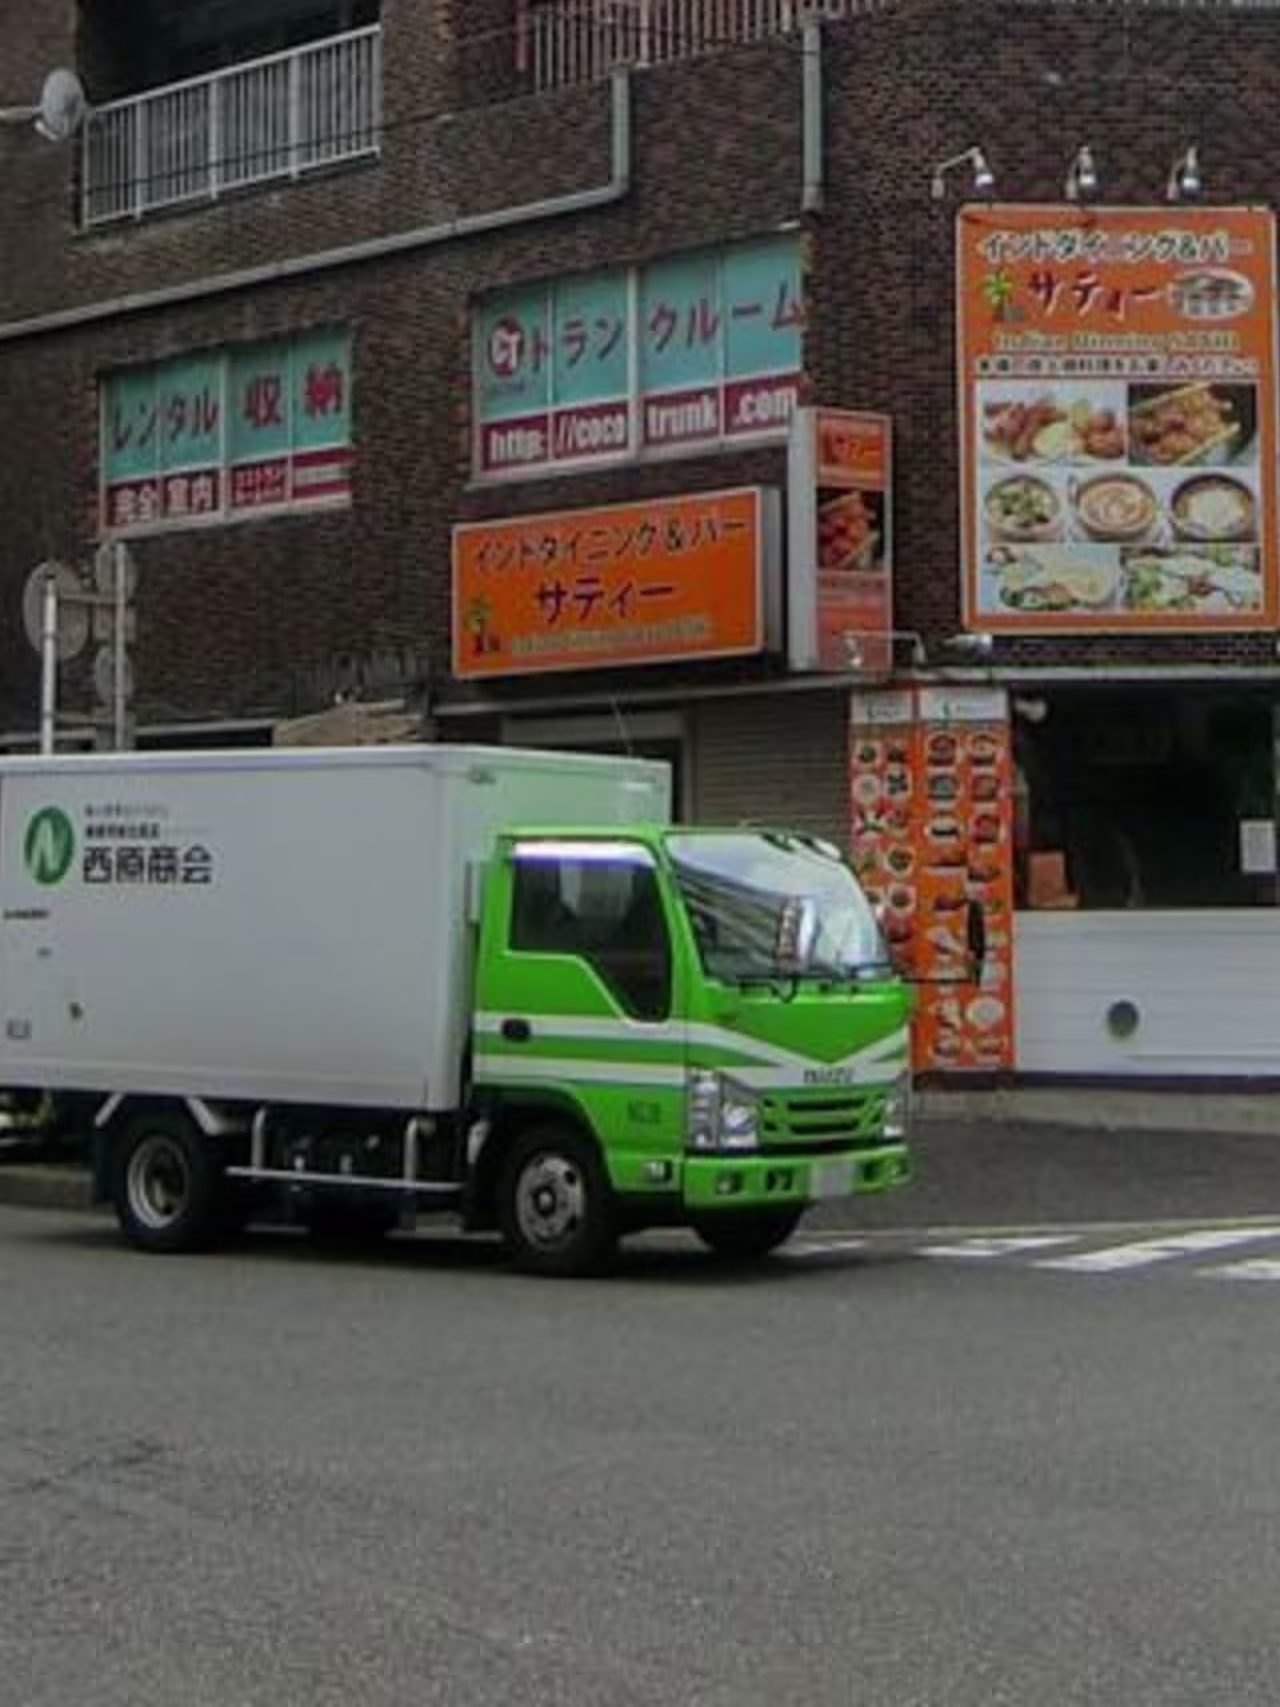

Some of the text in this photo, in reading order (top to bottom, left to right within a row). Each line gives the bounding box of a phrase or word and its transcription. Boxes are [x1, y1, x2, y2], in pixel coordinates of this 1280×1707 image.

[536, 577, 674, 623] サティー
[83, 845, 212, 884] 西原商会
